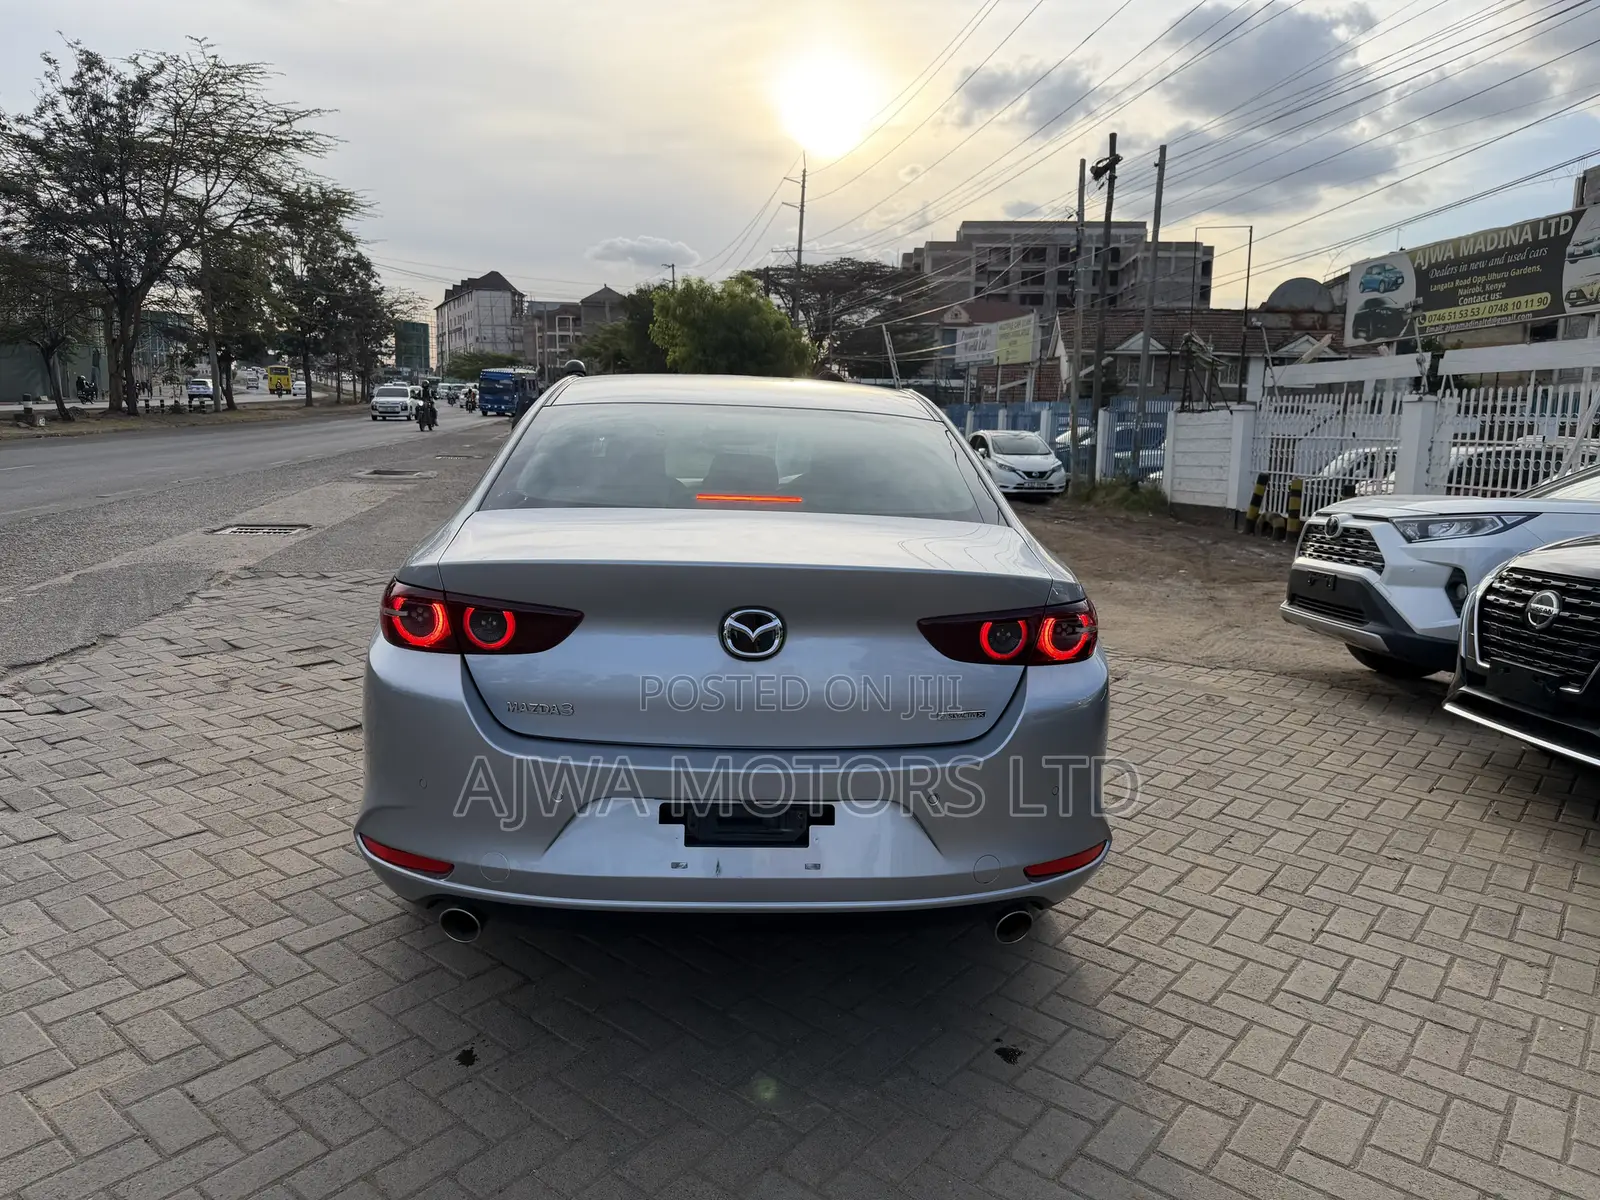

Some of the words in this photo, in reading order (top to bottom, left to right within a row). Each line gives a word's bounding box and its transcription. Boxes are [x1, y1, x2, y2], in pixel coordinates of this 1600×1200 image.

[1414, 244, 1454, 270] AJWA
[1459, 224, 1532, 257] MADINA
[1538, 215, 1573, 241] LTD
[1429, 264, 1457, 279] Dealers
[1459, 261, 1467, 272] in
[1470, 260, 1487, 270] new
[1489, 253, 1505, 267] and
[1507, 247, 1527, 260] used
[1529, 247, 1548, 258] cars
[1430, 281, 1454, 292] Langata
[1455, 277, 1471, 287] Road
[1510, 265, 1542, 277] Gardens,
[1458, 286, 1483, 296] Nairobi,
[1485, 282, 1506, 292] Kenya
[1458, 294, 1489, 306] Contact
[1491, 292, 1502, 300] us:
[1428, 313, 1445, 324] 0746
[1447, 311, 1456, 321] 51
[1459, 309, 1468, 319] 53
[1470, 308, 1480, 317] 53
[1488, 302, 1508, 314] 0748
[1511, 301, 1522, 311] 10
[1524, 298, 1534, 309] 11
[1536, 296, 1549, 307] 90
[1426, 324, 1443, 333] Email:
[1531, 604, 1555, 615] NISSAN
[506, 701, 575, 716] MAZDA3
